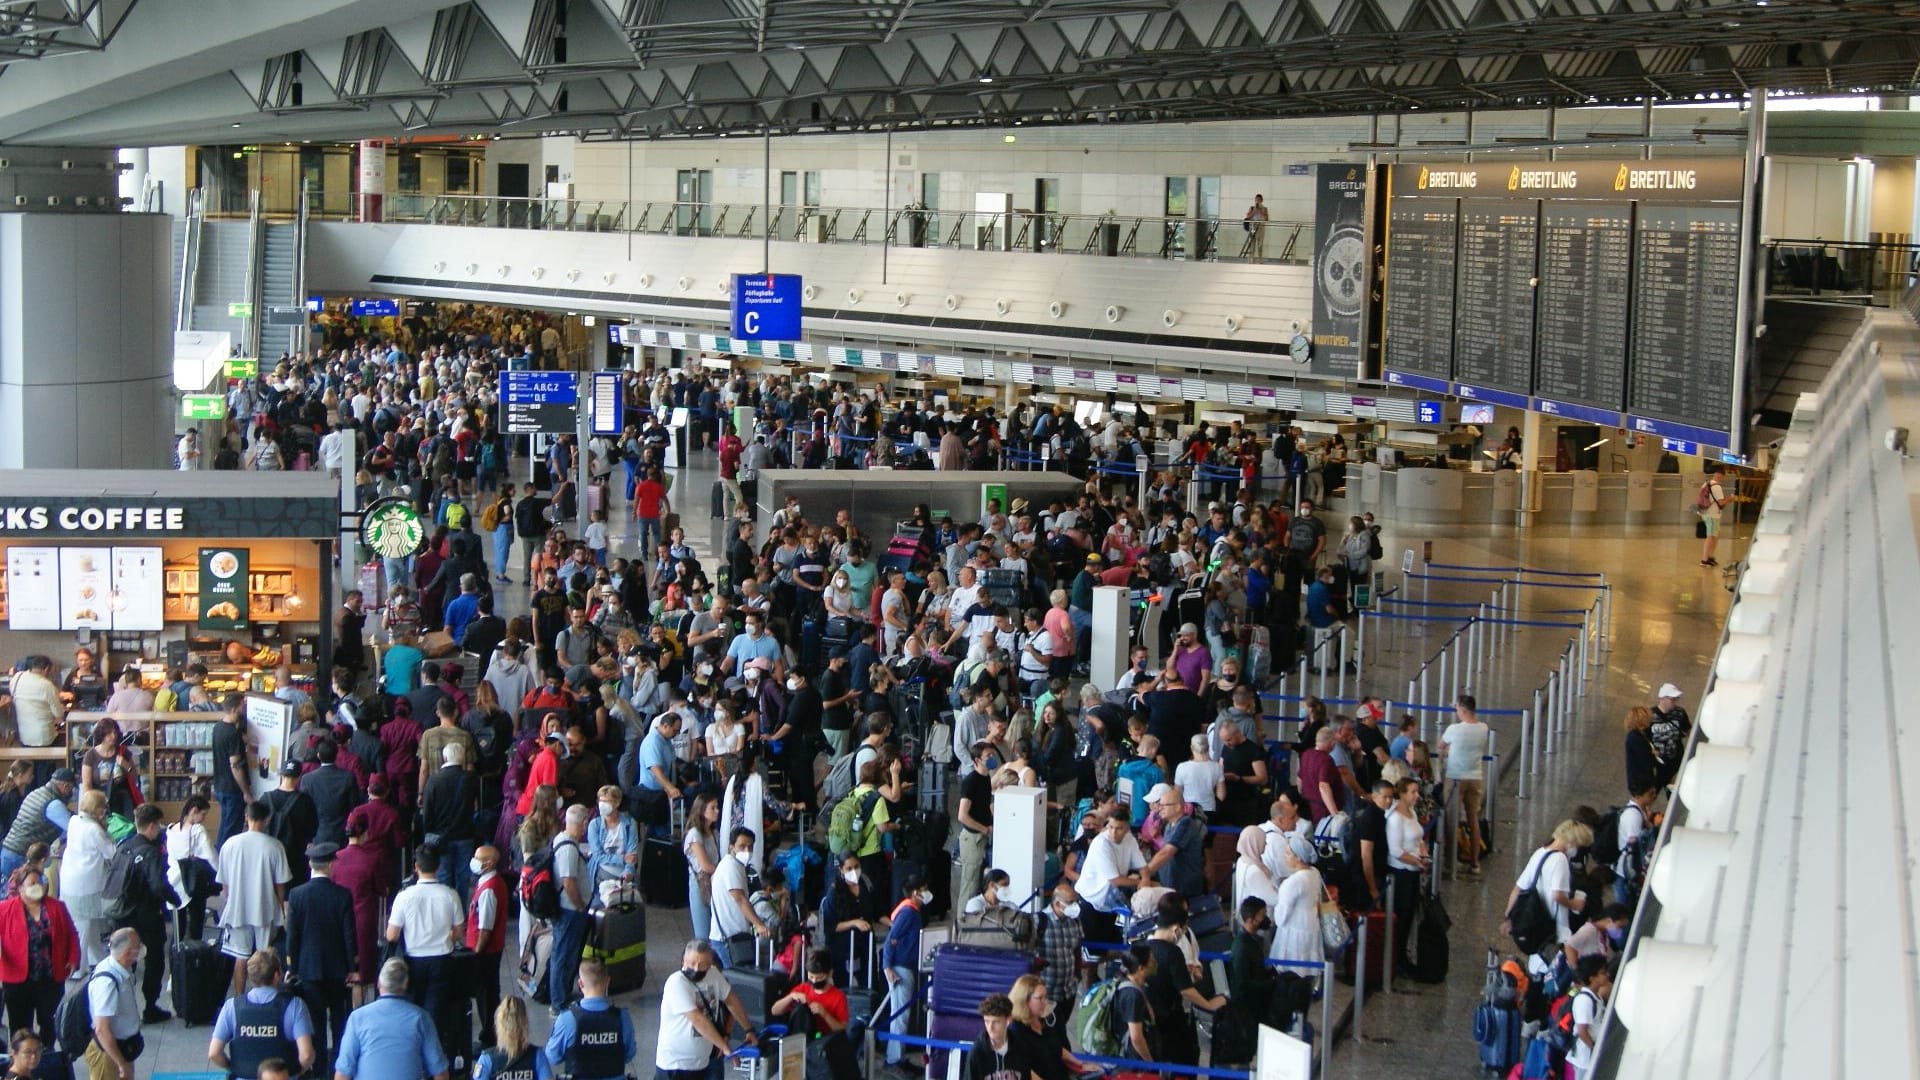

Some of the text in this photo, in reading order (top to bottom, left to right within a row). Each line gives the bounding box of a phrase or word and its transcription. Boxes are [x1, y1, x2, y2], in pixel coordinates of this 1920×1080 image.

[1329, 181, 1366, 190] BREITLIN
[1429, 171, 1477, 188] BREITLING
[1520, 171, 1577, 189] BREITLING
[1629, 170, 1696, 189] BREITLING
[744, 311, 760, 334] C
[0, 507, 184, 530] KS COFFEE
[240, 1025, 277, 1037] POLIZEI
[581, 1032, 618, 1045] POLIZEI
